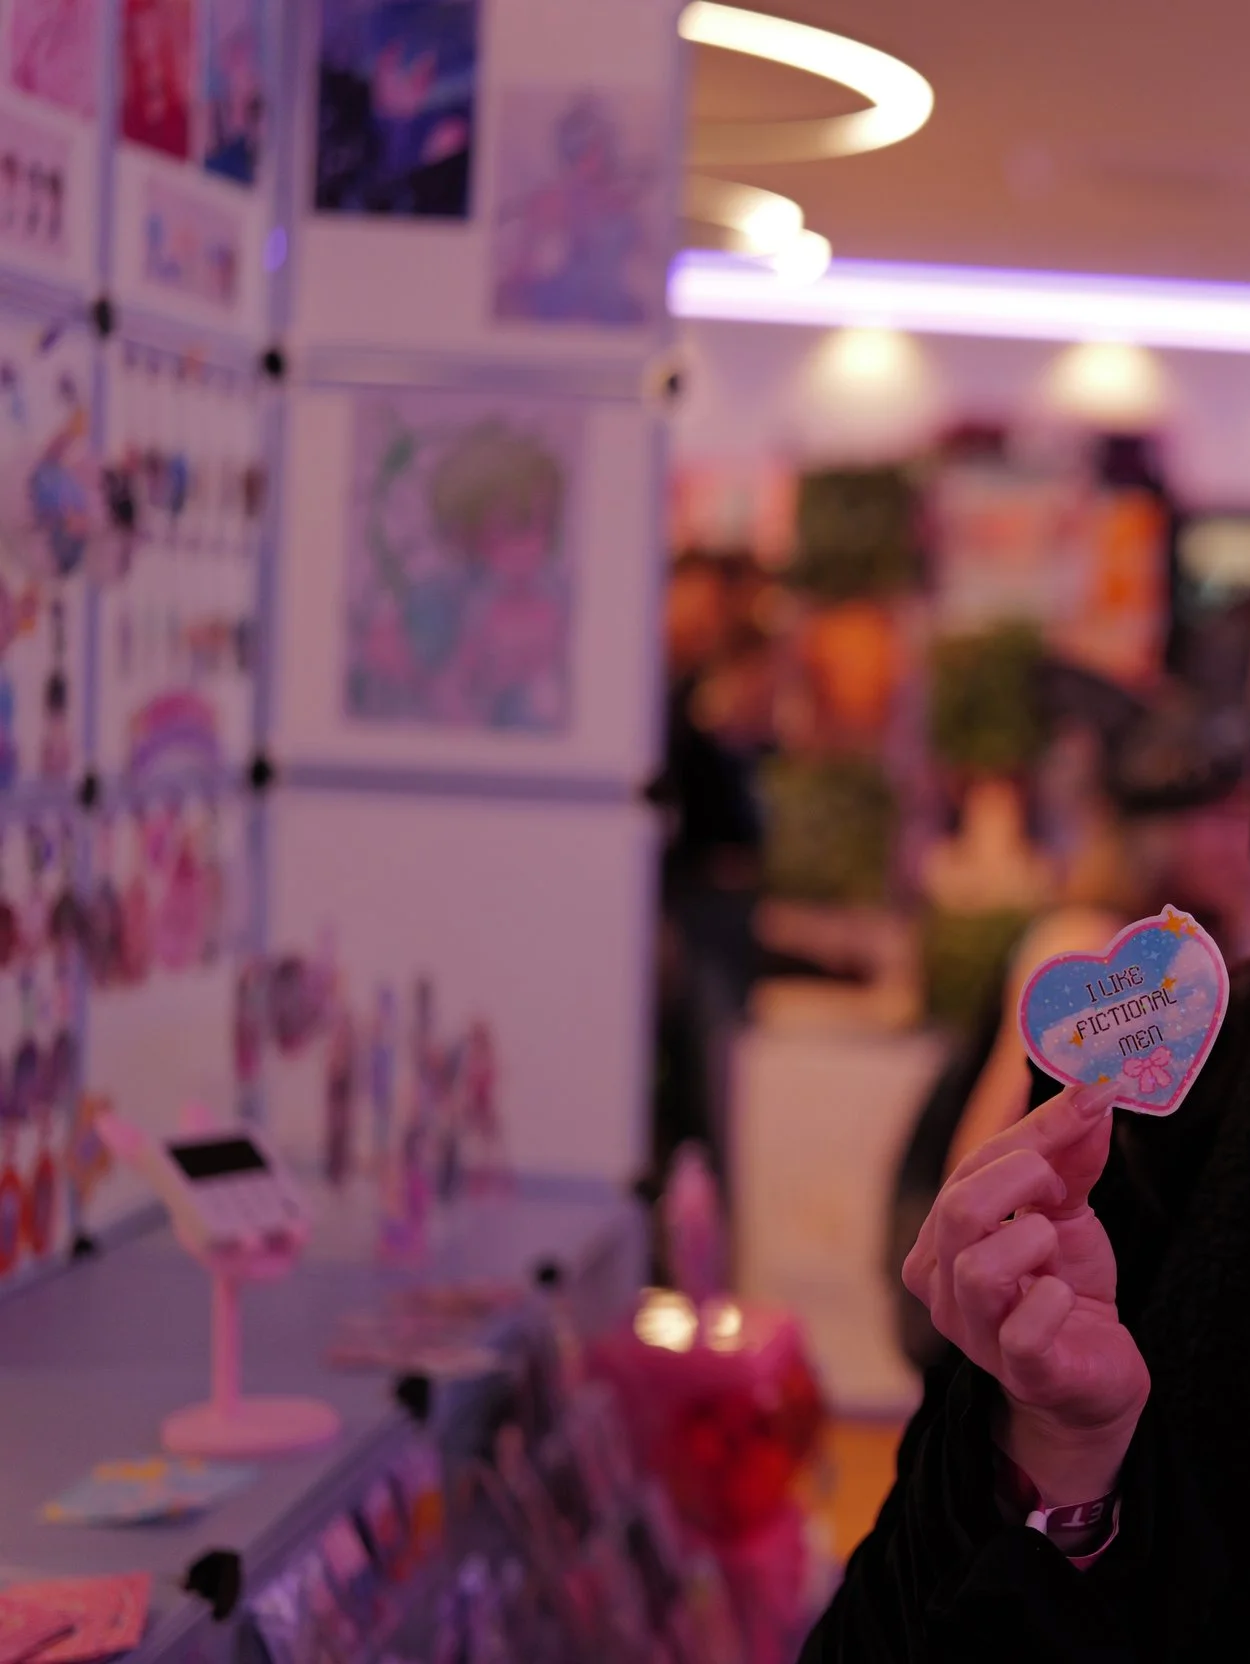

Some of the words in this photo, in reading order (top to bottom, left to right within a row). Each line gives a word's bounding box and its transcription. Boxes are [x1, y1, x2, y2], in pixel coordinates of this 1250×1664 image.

[1086, 984, 1098, 1002] I
[1098, 966, 1144, 997] LIKE
[1075, 987, 1177, 1040] FICTIONAL
[1118, 1025, 1163, 1056] MEN
